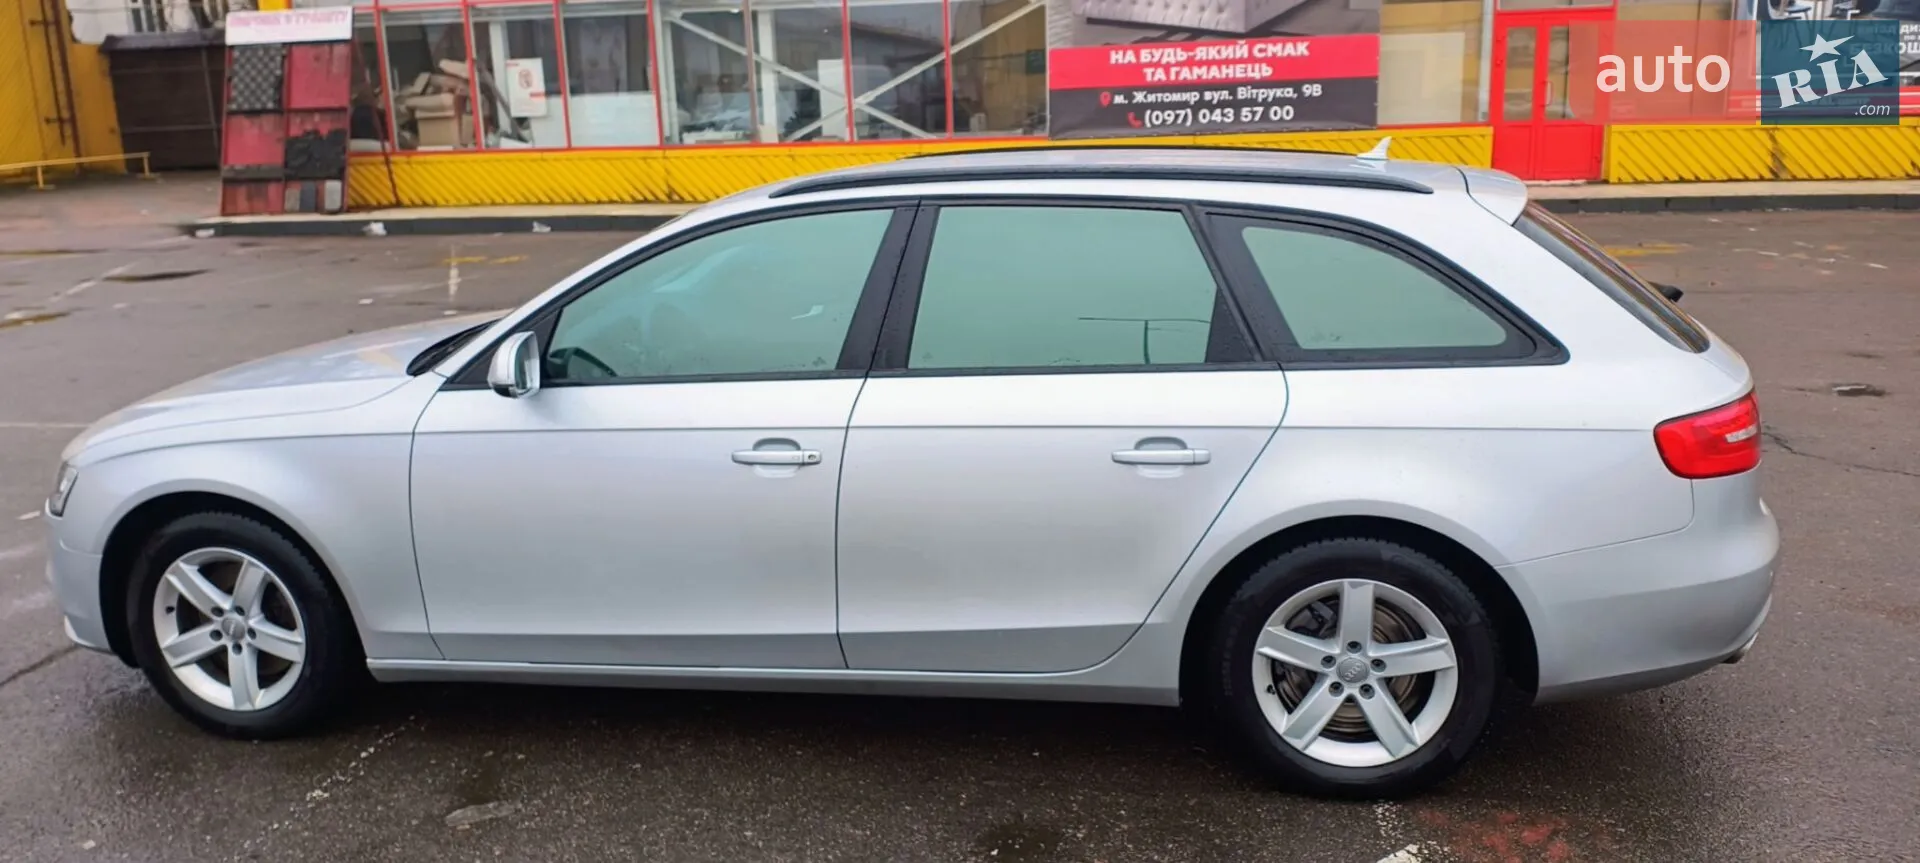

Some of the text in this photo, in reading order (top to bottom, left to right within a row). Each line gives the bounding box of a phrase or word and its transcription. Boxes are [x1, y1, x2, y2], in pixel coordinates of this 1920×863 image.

[1110, 40, 1310, 64] НА БУДЬ-ЯКИЙ СМАК
[1143, 63, 1273, 81] ТА ГАМАНЕЦЬ
[1113, 94, 1129, 104] м.
[1132, 91, 1200, 105] Житомир
[1204, 90, 1233, 105] вул.
[1237, 86, 1298, 102] Вітрука,
[1145, 105, 1295, 127] (097) 043 57 00
